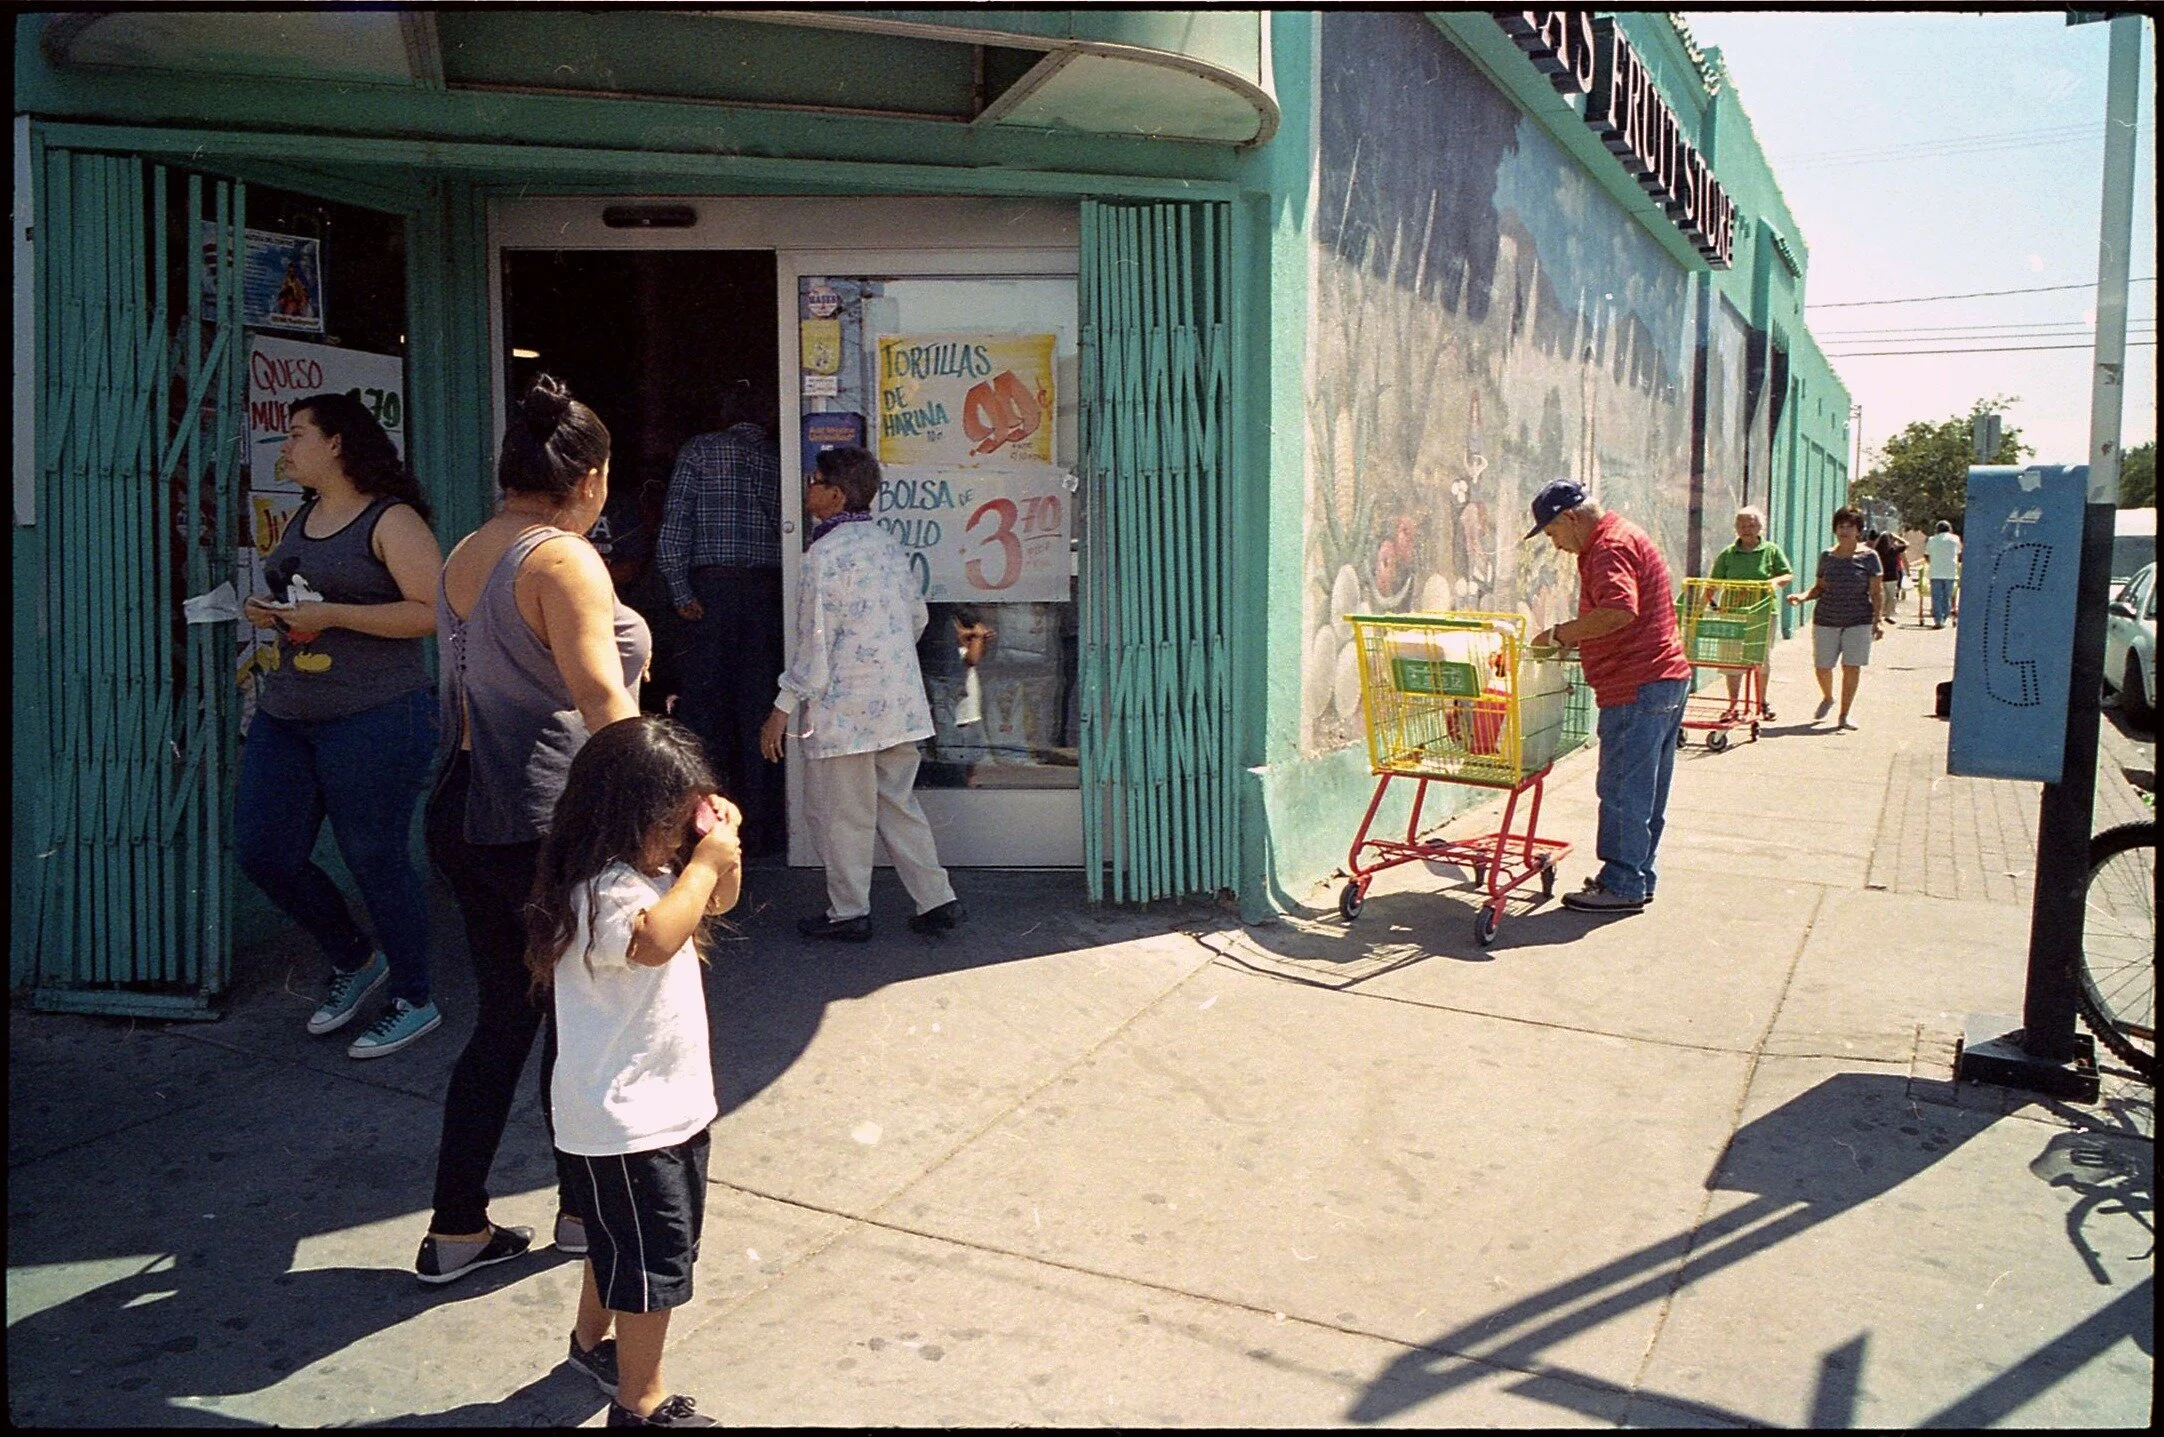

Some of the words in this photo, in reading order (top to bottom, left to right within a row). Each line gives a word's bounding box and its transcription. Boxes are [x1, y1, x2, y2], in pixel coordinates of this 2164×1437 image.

[1522, 11, 1595, 94] AS
[1608, 17, 1680, 202] FRUIT
[1685, 138, 1734, 271] STORE
[251, 350, 324, 395] QUESO
[881, 340, 992, 380] TORTILLAS
[251, 400, 290, 433] MUE
[883, 386, 909, 412] DE
[882, 401, 949, 438] HARINA
[877, 479, 955, 512] BOLSA
